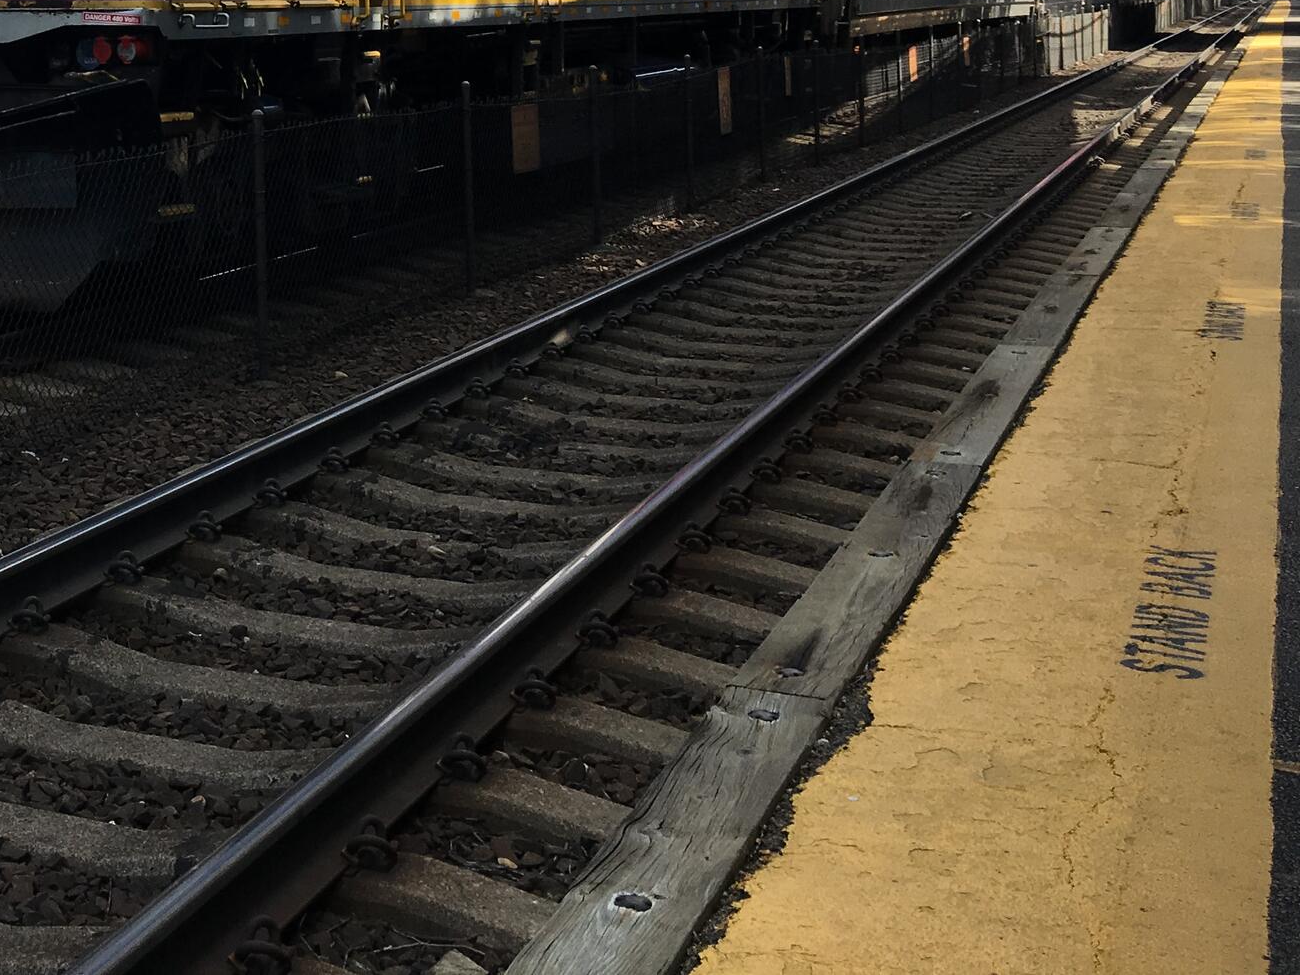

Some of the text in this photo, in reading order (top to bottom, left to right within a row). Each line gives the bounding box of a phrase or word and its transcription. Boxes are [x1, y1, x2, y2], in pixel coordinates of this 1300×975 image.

[84, 13, 111, 22] DANGER
[1120, 545, 1217, 679] STAND BACK
